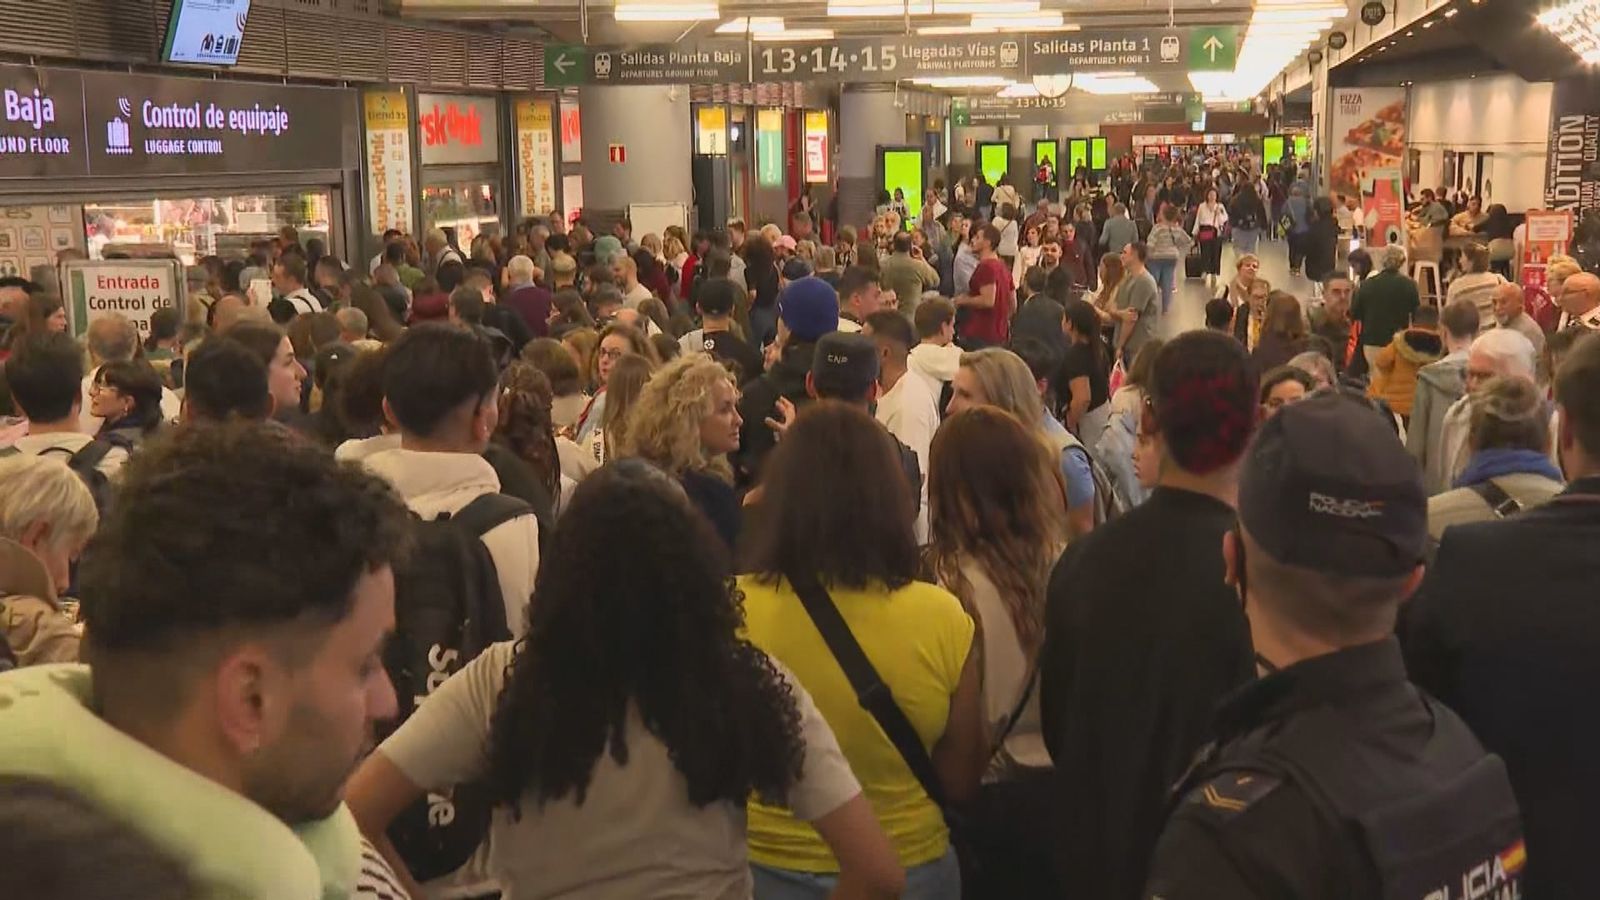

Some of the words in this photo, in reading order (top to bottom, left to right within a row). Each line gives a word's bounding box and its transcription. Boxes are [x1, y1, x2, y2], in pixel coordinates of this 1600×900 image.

[902, 42, 963, 59] Llegadas
[968, 42, 997, 57] Vías
[1033, 40, 1085, 54] Salidas
[1090, 38, 1137, 52] Planta
[1142, 38, 1151, 51] 1
[620, 52, 665, 65] Salidas
[669, 51, 710, 64] Planta
[714, 50, 742, 66] Baja
[916, 60, 951, 69] ARRIVALS
[1069, 56, 1117, 65] DEPARTURES
[1119, 55, 1143, 64] FLOOR
[1145, 55, 1150, 63] 1
[621, 70, 662, 78] DEPARTURES
[665, 70, 694, 78] GROUND
[697, 69, 719, 77] FLOOR
[1340, 94, 1362, 105] PIZZA
[4, 88, 55, 130] Baja
[143, 100, 200, 129] Control
[205, 103, 224, 128] de
[229, 103, 289, 136] equipaje
[30, 137, 70, 153] FLOOR
[145, 139, 185, 154] LUGGAGE
[187, 140, 223, 154] CONTROL
[1584, 115, 1600, 162] QUALITY
[1554, 114, 1585, 228] ADITION
[97, 274, 160, 290] Entrada
[89, 296, 146, 310] Control
[152, 295, 172, 310] de
